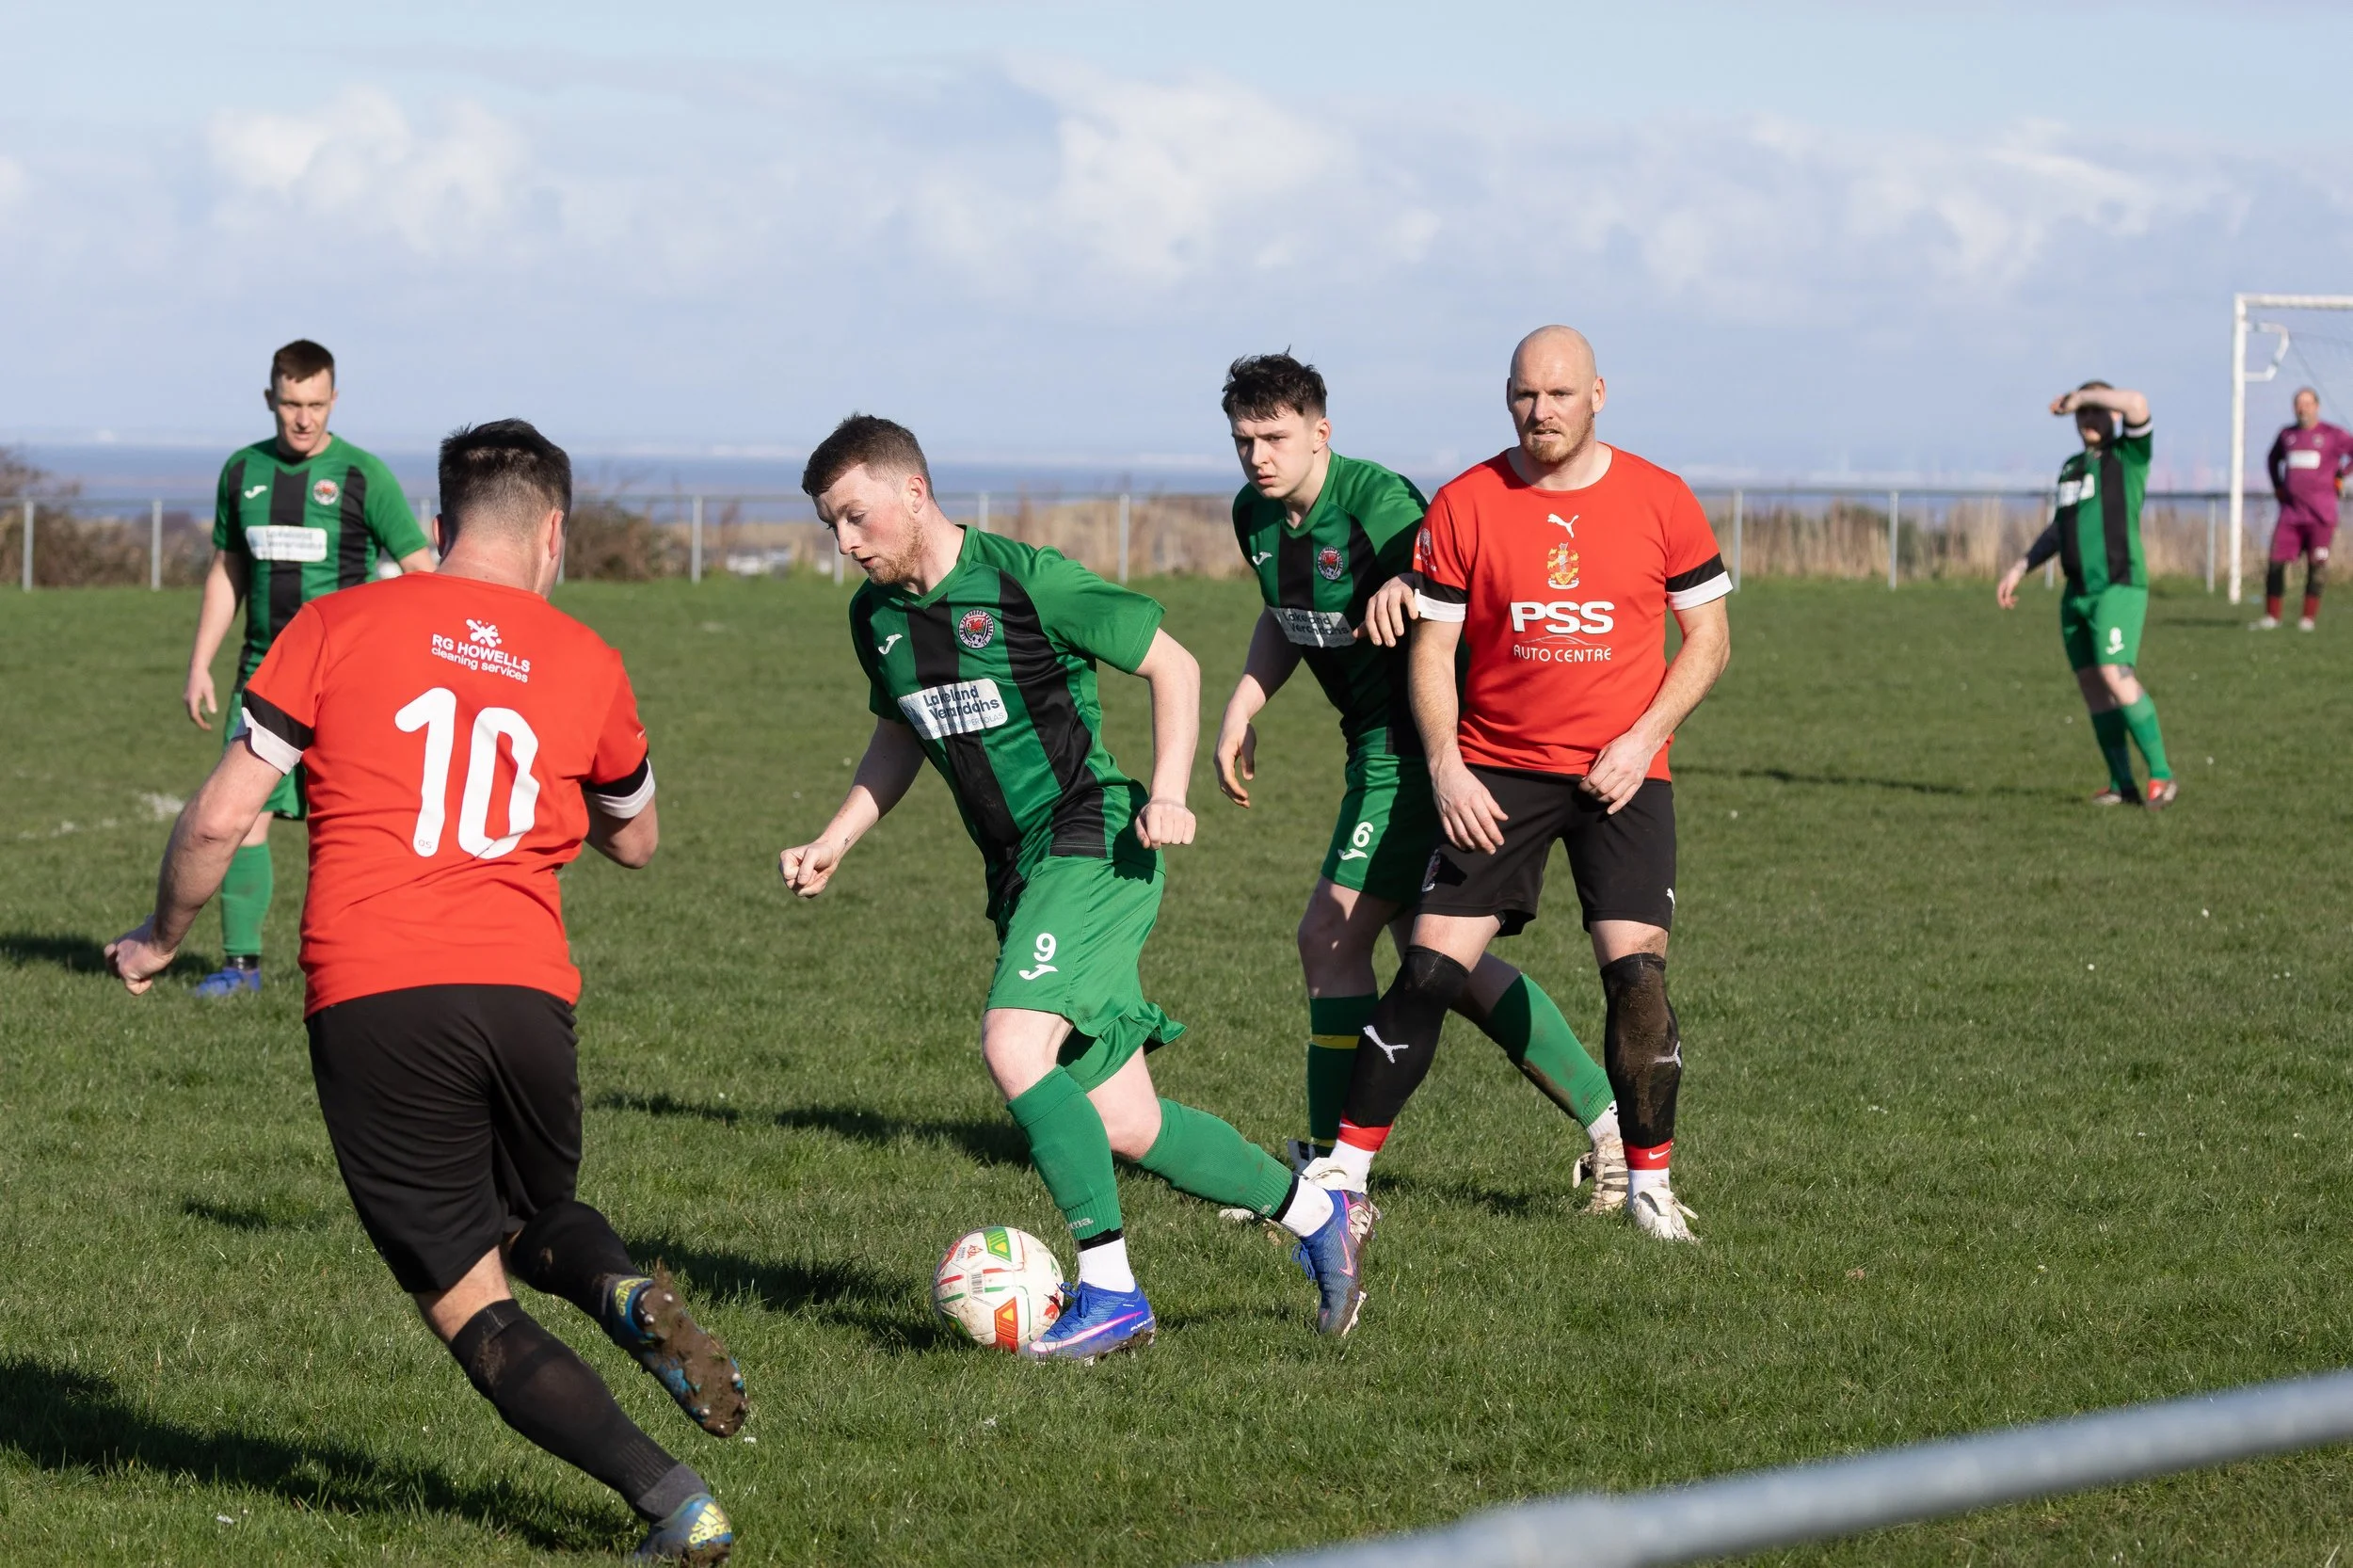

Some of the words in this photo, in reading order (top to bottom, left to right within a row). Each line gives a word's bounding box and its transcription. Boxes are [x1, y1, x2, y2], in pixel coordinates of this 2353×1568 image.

[1510, 600, 1615, 634] PSS
[431, 647, 479, 671] cleaning
[481, 662, 529, 683] services
[432, 633, 455, 651] RG
[456, 641, 531, 673] HOWELLS
[1513, 644, 1551, 663] AUTO
[1555, 647, 1612, 663] CENTRE
[922, 685, 980, 708] Lakeland
[966, 712, 1004, 727] PEROLAS
[394, 687, 540, 860] 10
[1353, 821, 1374, 847] 6
[1033, 933, 1057, 962] 9
